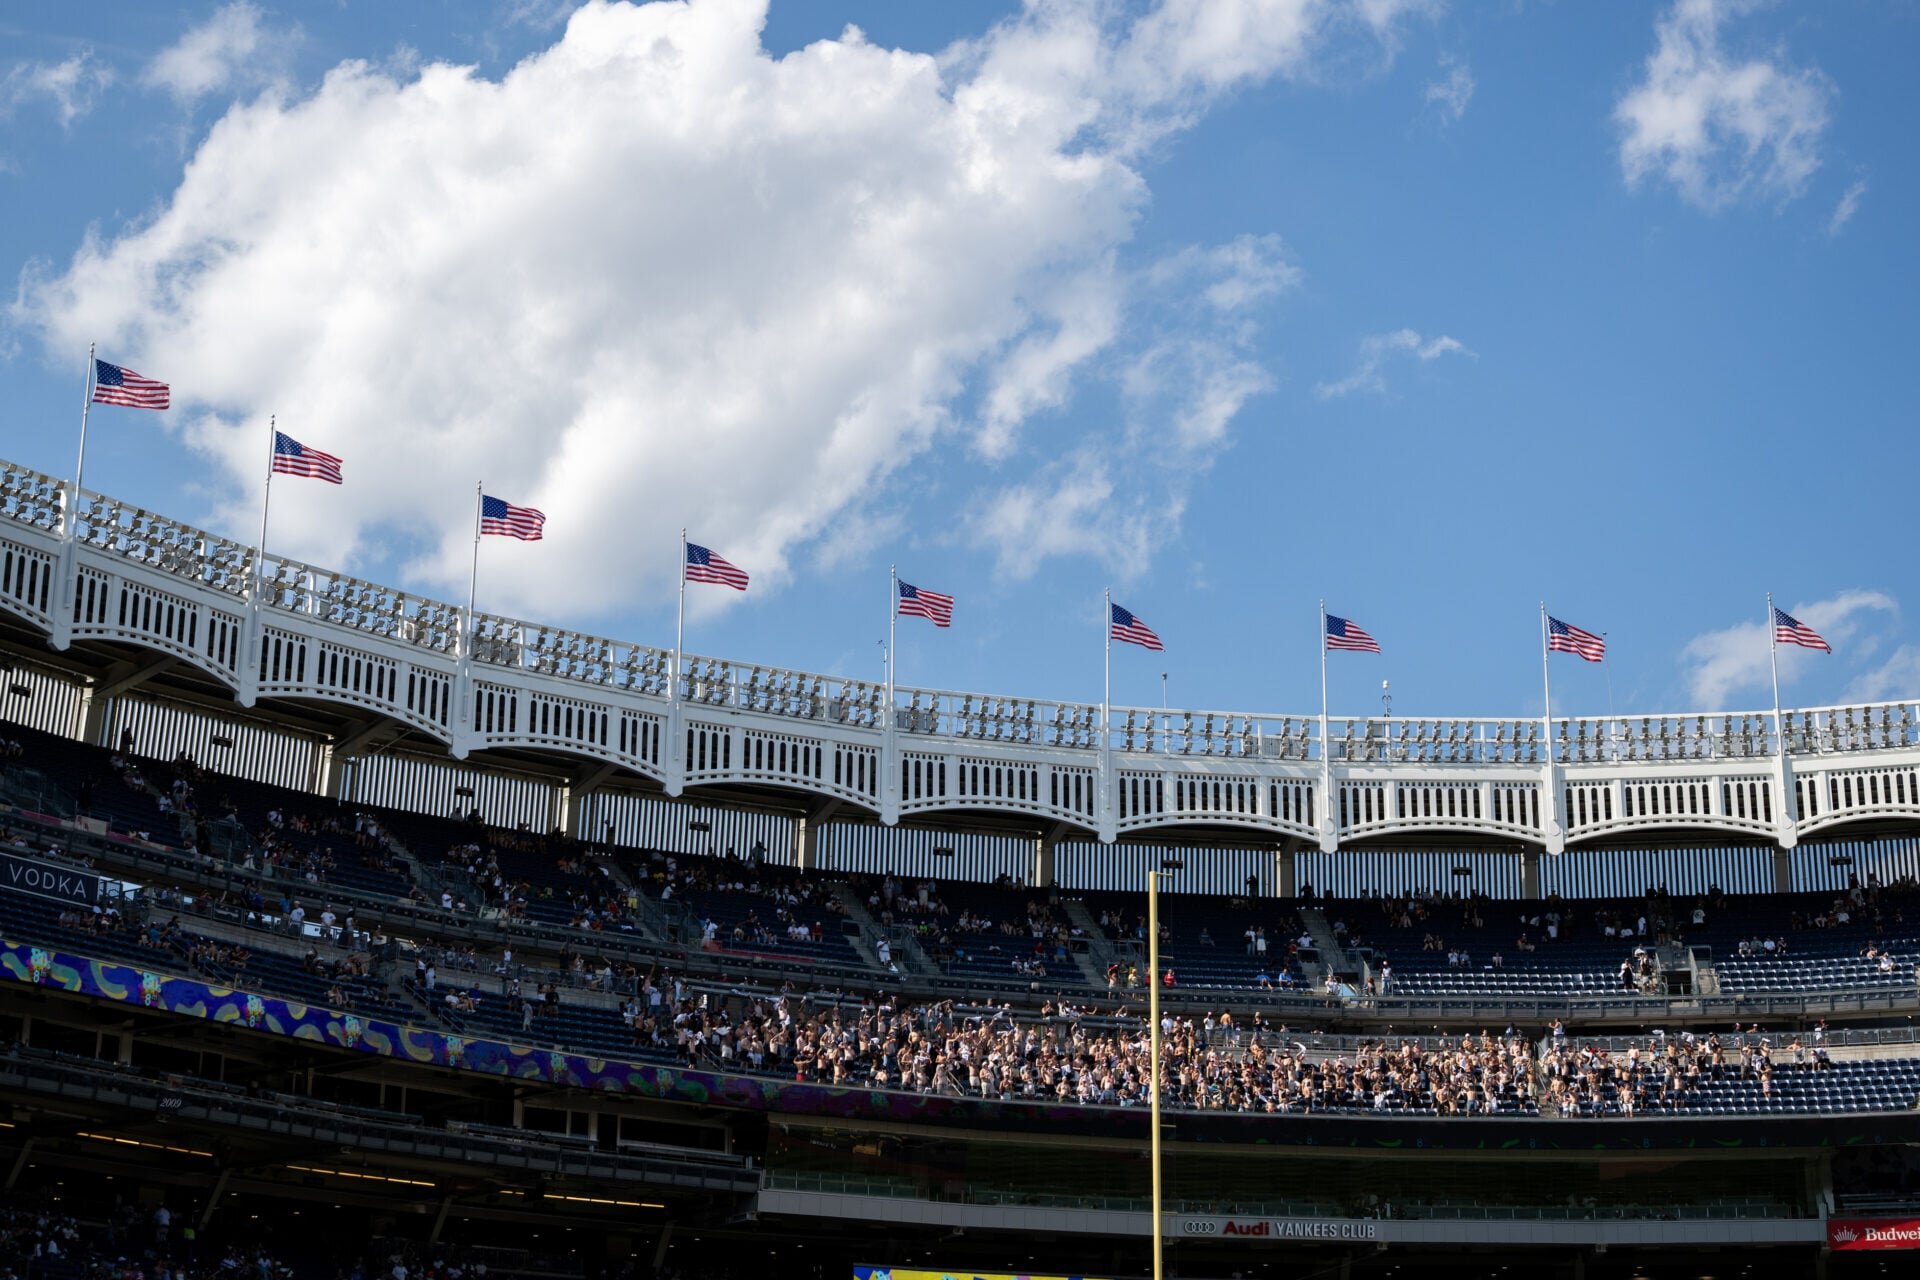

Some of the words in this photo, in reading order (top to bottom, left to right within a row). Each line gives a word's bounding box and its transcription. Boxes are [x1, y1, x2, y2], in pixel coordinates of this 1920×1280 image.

[9, 863, 87, 899] VODKA
[1223, 1220, 1270, 1236] Audi
[1276, 1221, 1337, 1238] YANKEES
[1341, 1224, 1376, 1239] CLUB
